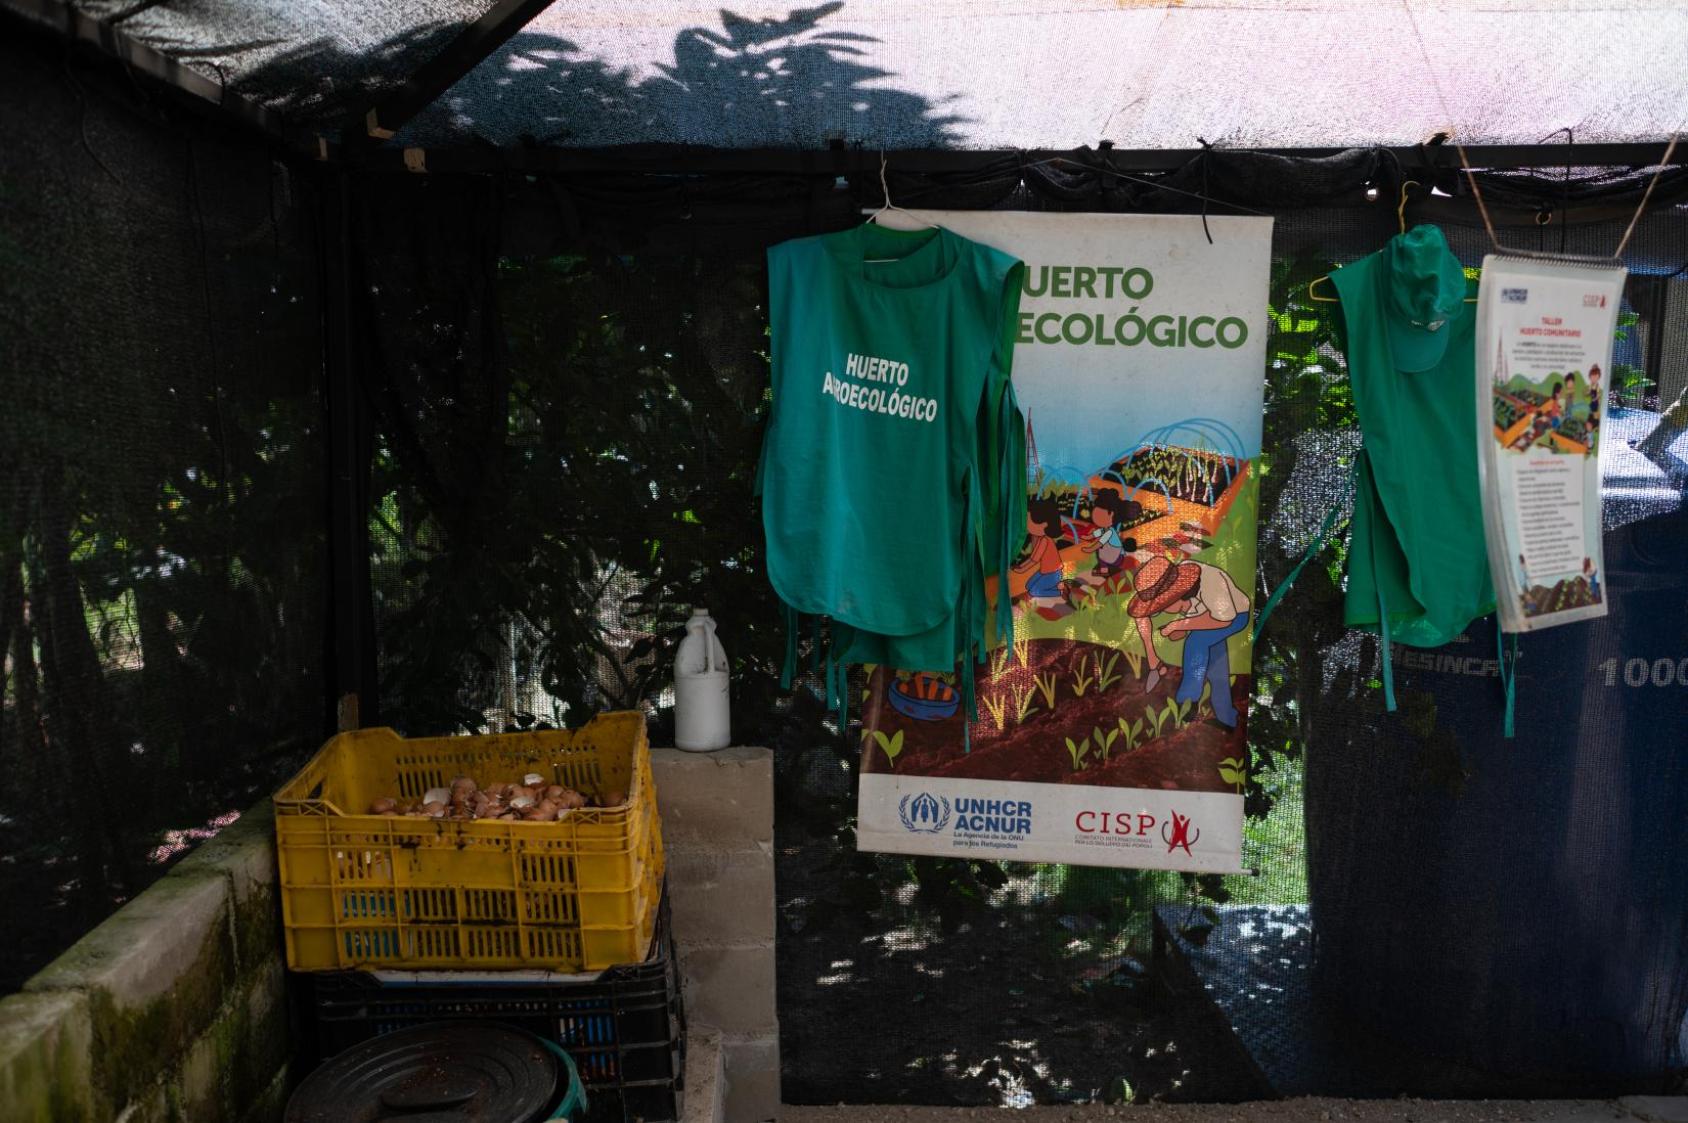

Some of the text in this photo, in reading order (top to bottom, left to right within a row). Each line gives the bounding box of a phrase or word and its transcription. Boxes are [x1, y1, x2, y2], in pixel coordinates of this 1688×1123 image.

[1022, 265, 1154, 300] UERTO
[1014, 306, 1249, 349] ECOLÓGICO
[1541, 316, 1563, 325] TALLER
[1520, 327, 1582, 337] HUERTO COMUNITARIO
[845, 352, 909, 387] HUERTO
[822, 371, 938, 423] AROECOLÓGICO
[955, 798, 1032, 817] UNHCR
[954, 815, 1031, 834] ACNUR
[1075, 811, 1156, 836] CISP
[953, 840, 969, 848] para
[980, 840, 1018, 849] Refugiados
[963, 832, 990, 840] Agencia
